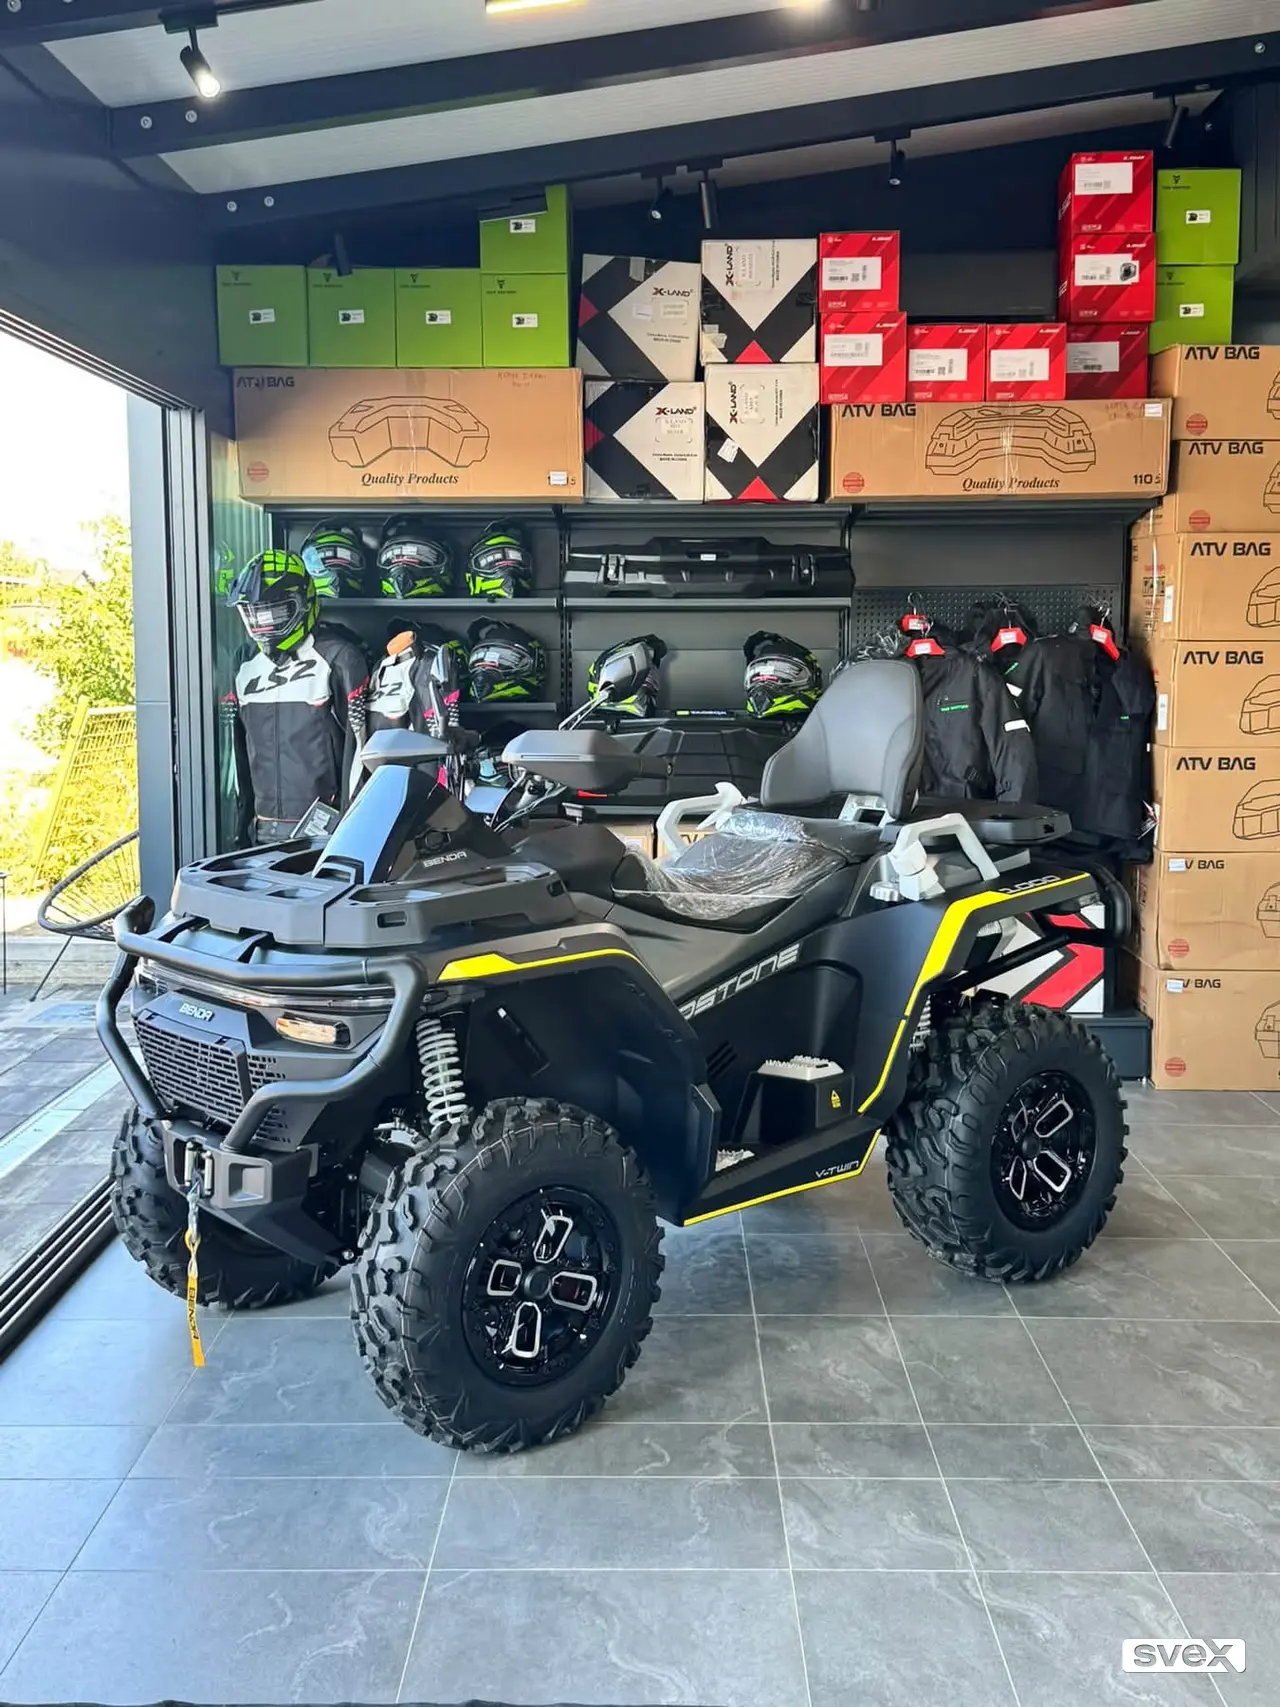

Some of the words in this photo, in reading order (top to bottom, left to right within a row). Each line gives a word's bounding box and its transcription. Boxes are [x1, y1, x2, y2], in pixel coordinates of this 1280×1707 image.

[652, 287, 691, 297] X-LAND
[1185, 346, 1219, 360] ATV
[1224, 346, 1260, 360] BAG
[267, 376, 295, 388] BAG
[729, 384, 738, 424] X-LAND
[841, 404, 876, 417] ATV
[881, 404, 917, 417] BAG
[655, 407, 694, 415] X-LAND
[1188, 442, 1222, 455] ATV
[1228, 441, 1264, 454] BAG
[361, 473, 405, 486] Quality
[407, 473, 459, 484] Products
[962, 477, 1005, 491] Quality
[1007, 477, 1060, 488] Products
[1190, 542, 1227, 556] ATV
[1233, 542, 1271, 556] BAG
[1183, 651, 1220, 664] ATV
[1225, 651, 1264, 664] BAG
[243, 659, 317, 695] LS2
[1176, 757, 1213, 770] ATV
[1218, 757, 1256, 770] BAG
[423, 851, 467, 867] BENDA
[1197, 860, 1224, 869] BAG
[1194, 979, 1221, 988] BAG
[179, 1003, 214, 1021] BENDA
